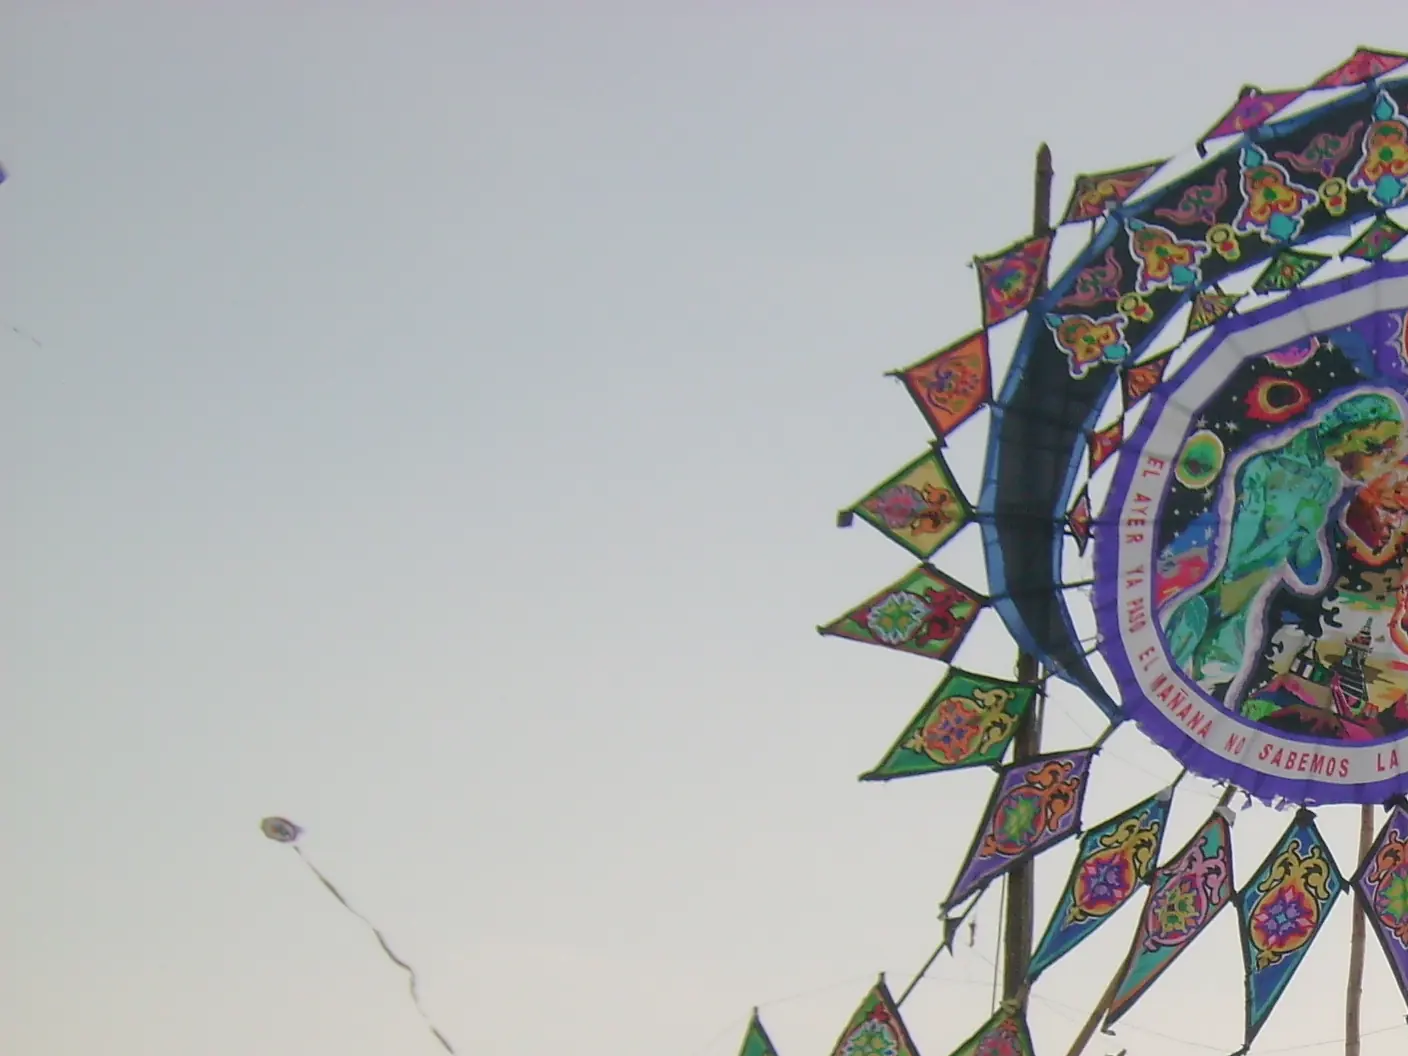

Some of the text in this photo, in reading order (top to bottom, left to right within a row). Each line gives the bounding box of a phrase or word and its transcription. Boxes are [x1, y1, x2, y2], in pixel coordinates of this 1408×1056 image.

[1142, 455, 1165, 478] EL
[1125, 493, 1152, 544] AYER
[1126, 565, 1144, 589] YA
[1151, 673, 1214, 740] MAÑANA
[1224, 732, 1246, 756] NO
[1258, 743, 1350, 778] SABEMOS
[1376, 748, 1399, 772] LA
